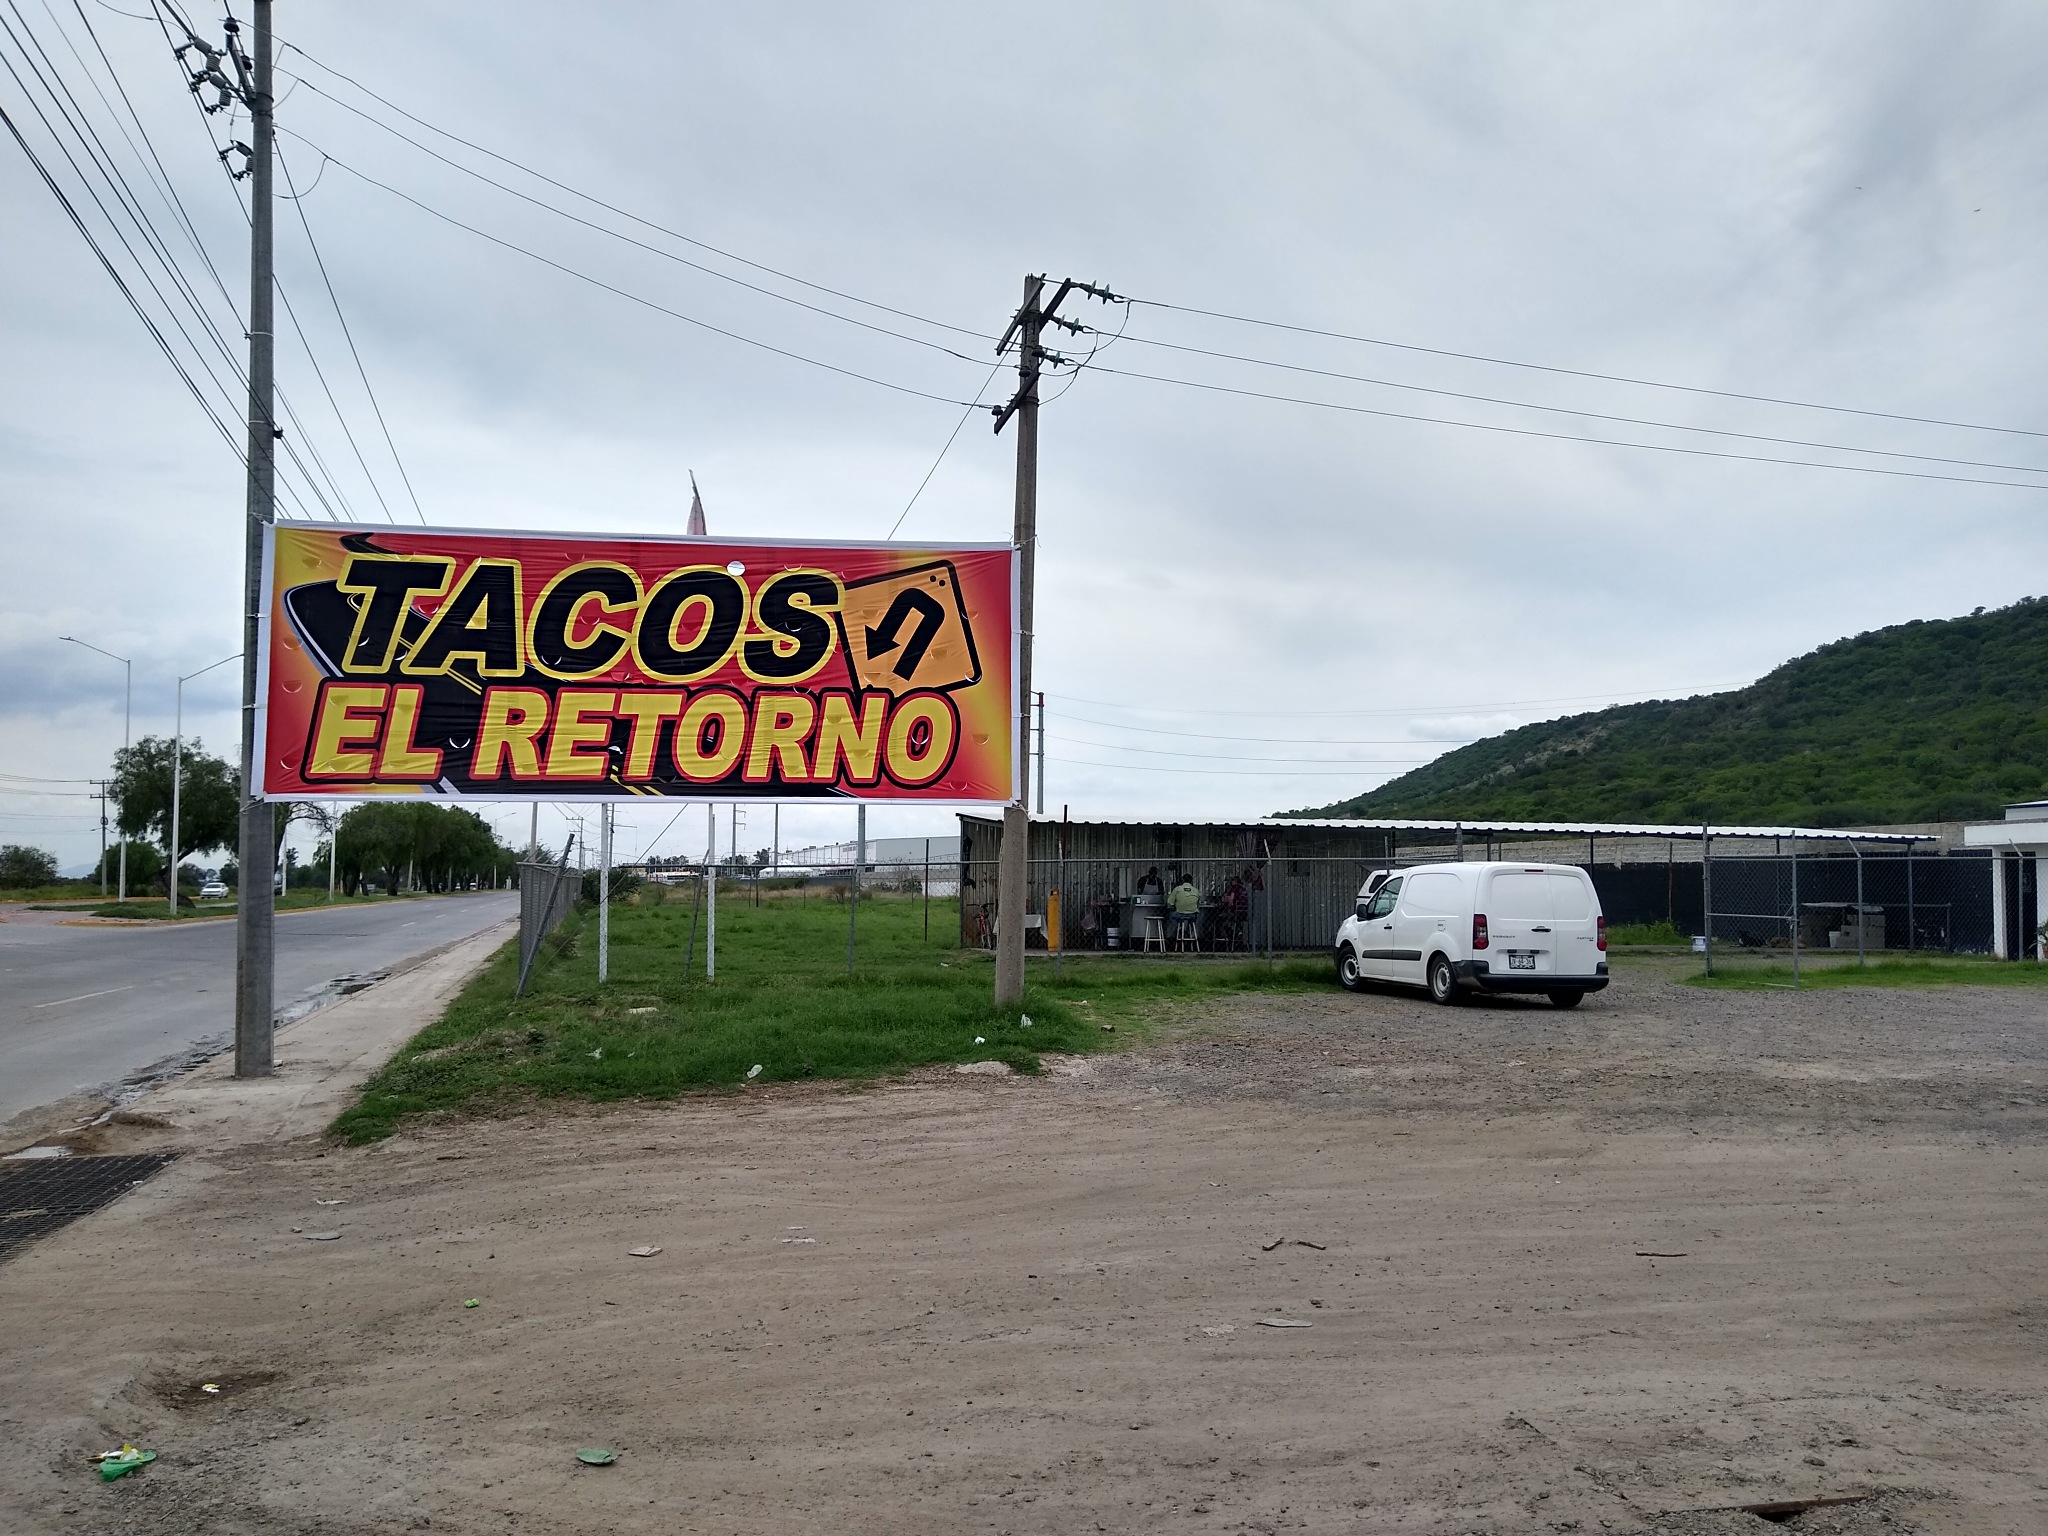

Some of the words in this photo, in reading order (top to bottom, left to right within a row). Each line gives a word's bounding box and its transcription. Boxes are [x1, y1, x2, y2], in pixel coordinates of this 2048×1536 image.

[338, 553, 845, 683] TACOS
[305, 684, 443, 783] EL
[470, 685, 957, 787] RETORNO
